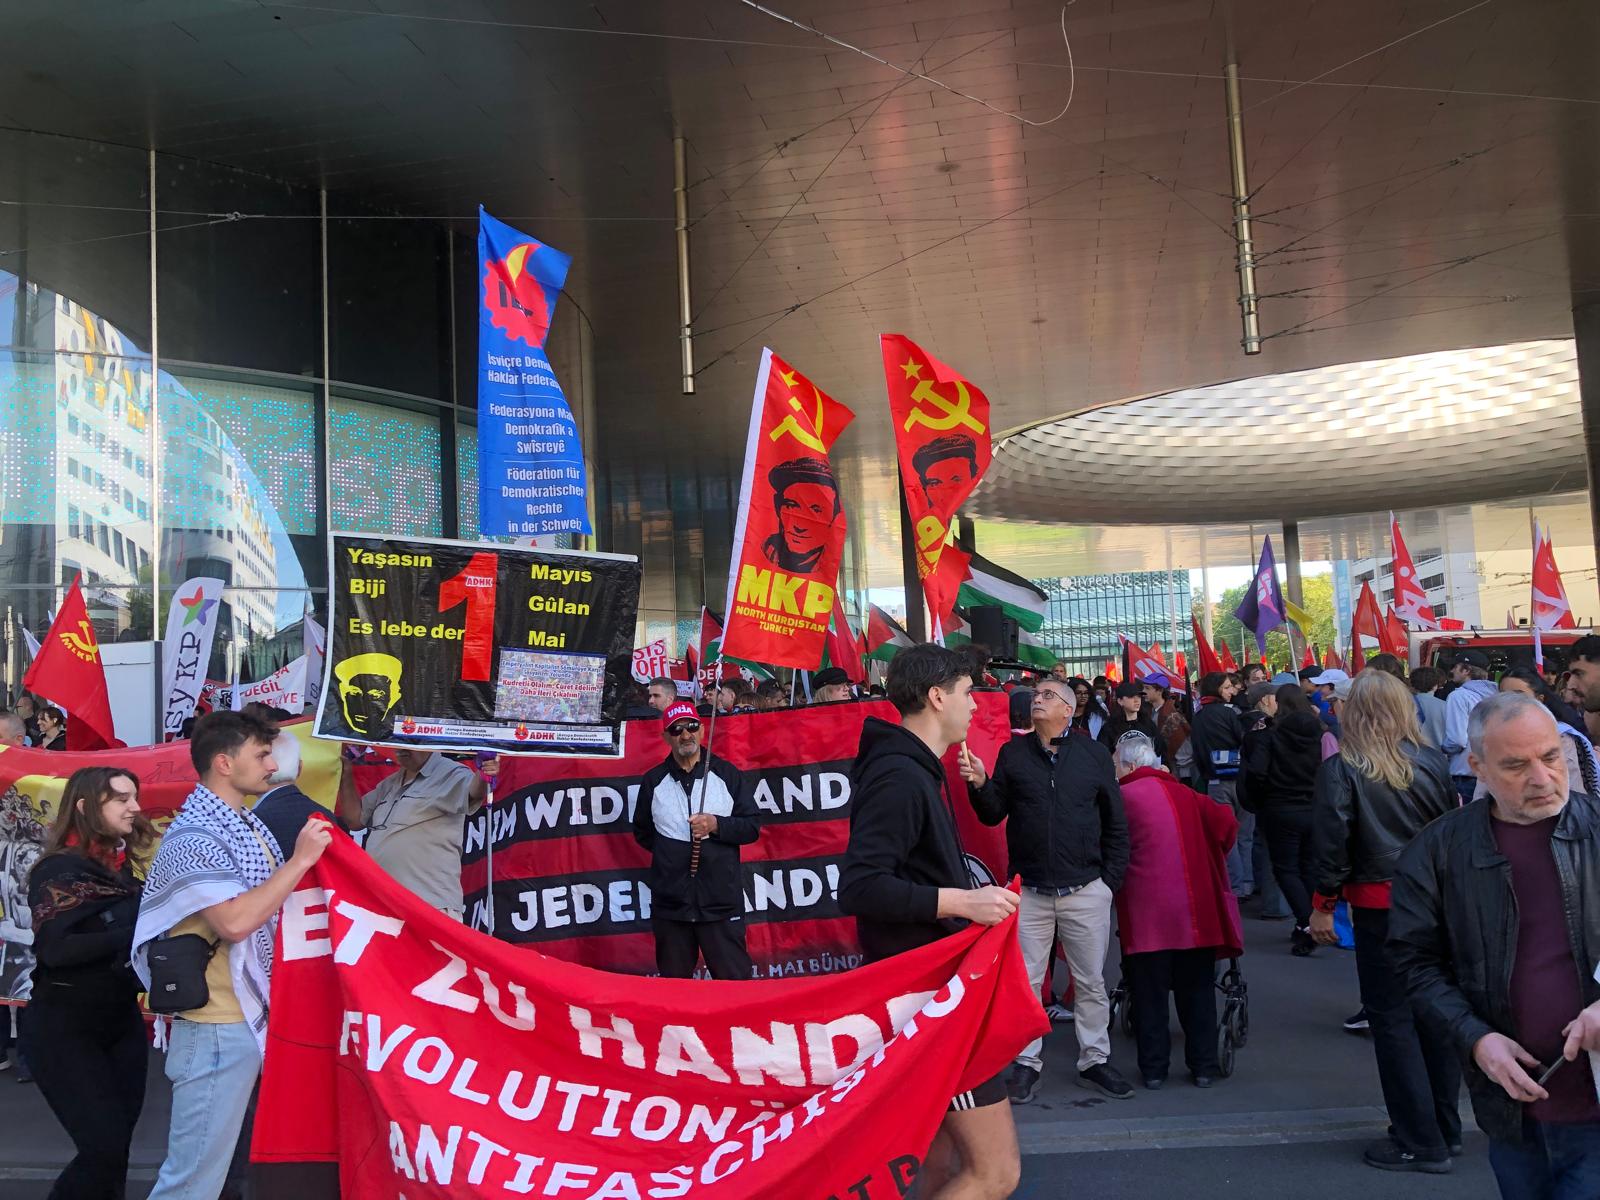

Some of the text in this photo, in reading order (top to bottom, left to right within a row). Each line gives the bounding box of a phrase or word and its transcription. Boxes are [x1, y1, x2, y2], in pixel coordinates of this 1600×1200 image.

[487, 369, 519, 385] Haklar
[489, 402, 555, 419] Federasyona
[567, 426, 574, 437] a
[516, 439, 565, 454] Swîsreyê
[507, 466, 580, 480] Föderation für
[526, 503, 563, 516] Rechte
[508, 518, 582, 533] in der Schweiz
[347, 547, 433, 569] Yaşasın
[466, 577, 493, 587] ADHK
[531, 564, 593, 585] Mayıs
[350, 578, 386, 598] Bijî
[736, 563, 835, 619] MKP
[528, 595, 590, 616] Gûlan
[438, 552, 498, 682] 1
[735, 605, 826, 633] NORTH KURDISTAN
[349, 618, 466, 641] Es lebe der
[759, 621, 796, 636] TURKEY
[528, 630, 566, 648] Mai
[636, 655, 667, 678] OFF
[417, 725, 444, 735] ADHK
[529, 732, 555, 740] ADHK
[753, 772, 851, 814] AND
[769, 959, 805, 978] MAI
[809, 952, 864, 973] BÜND
[411, 939, 536, 1031] ZU
